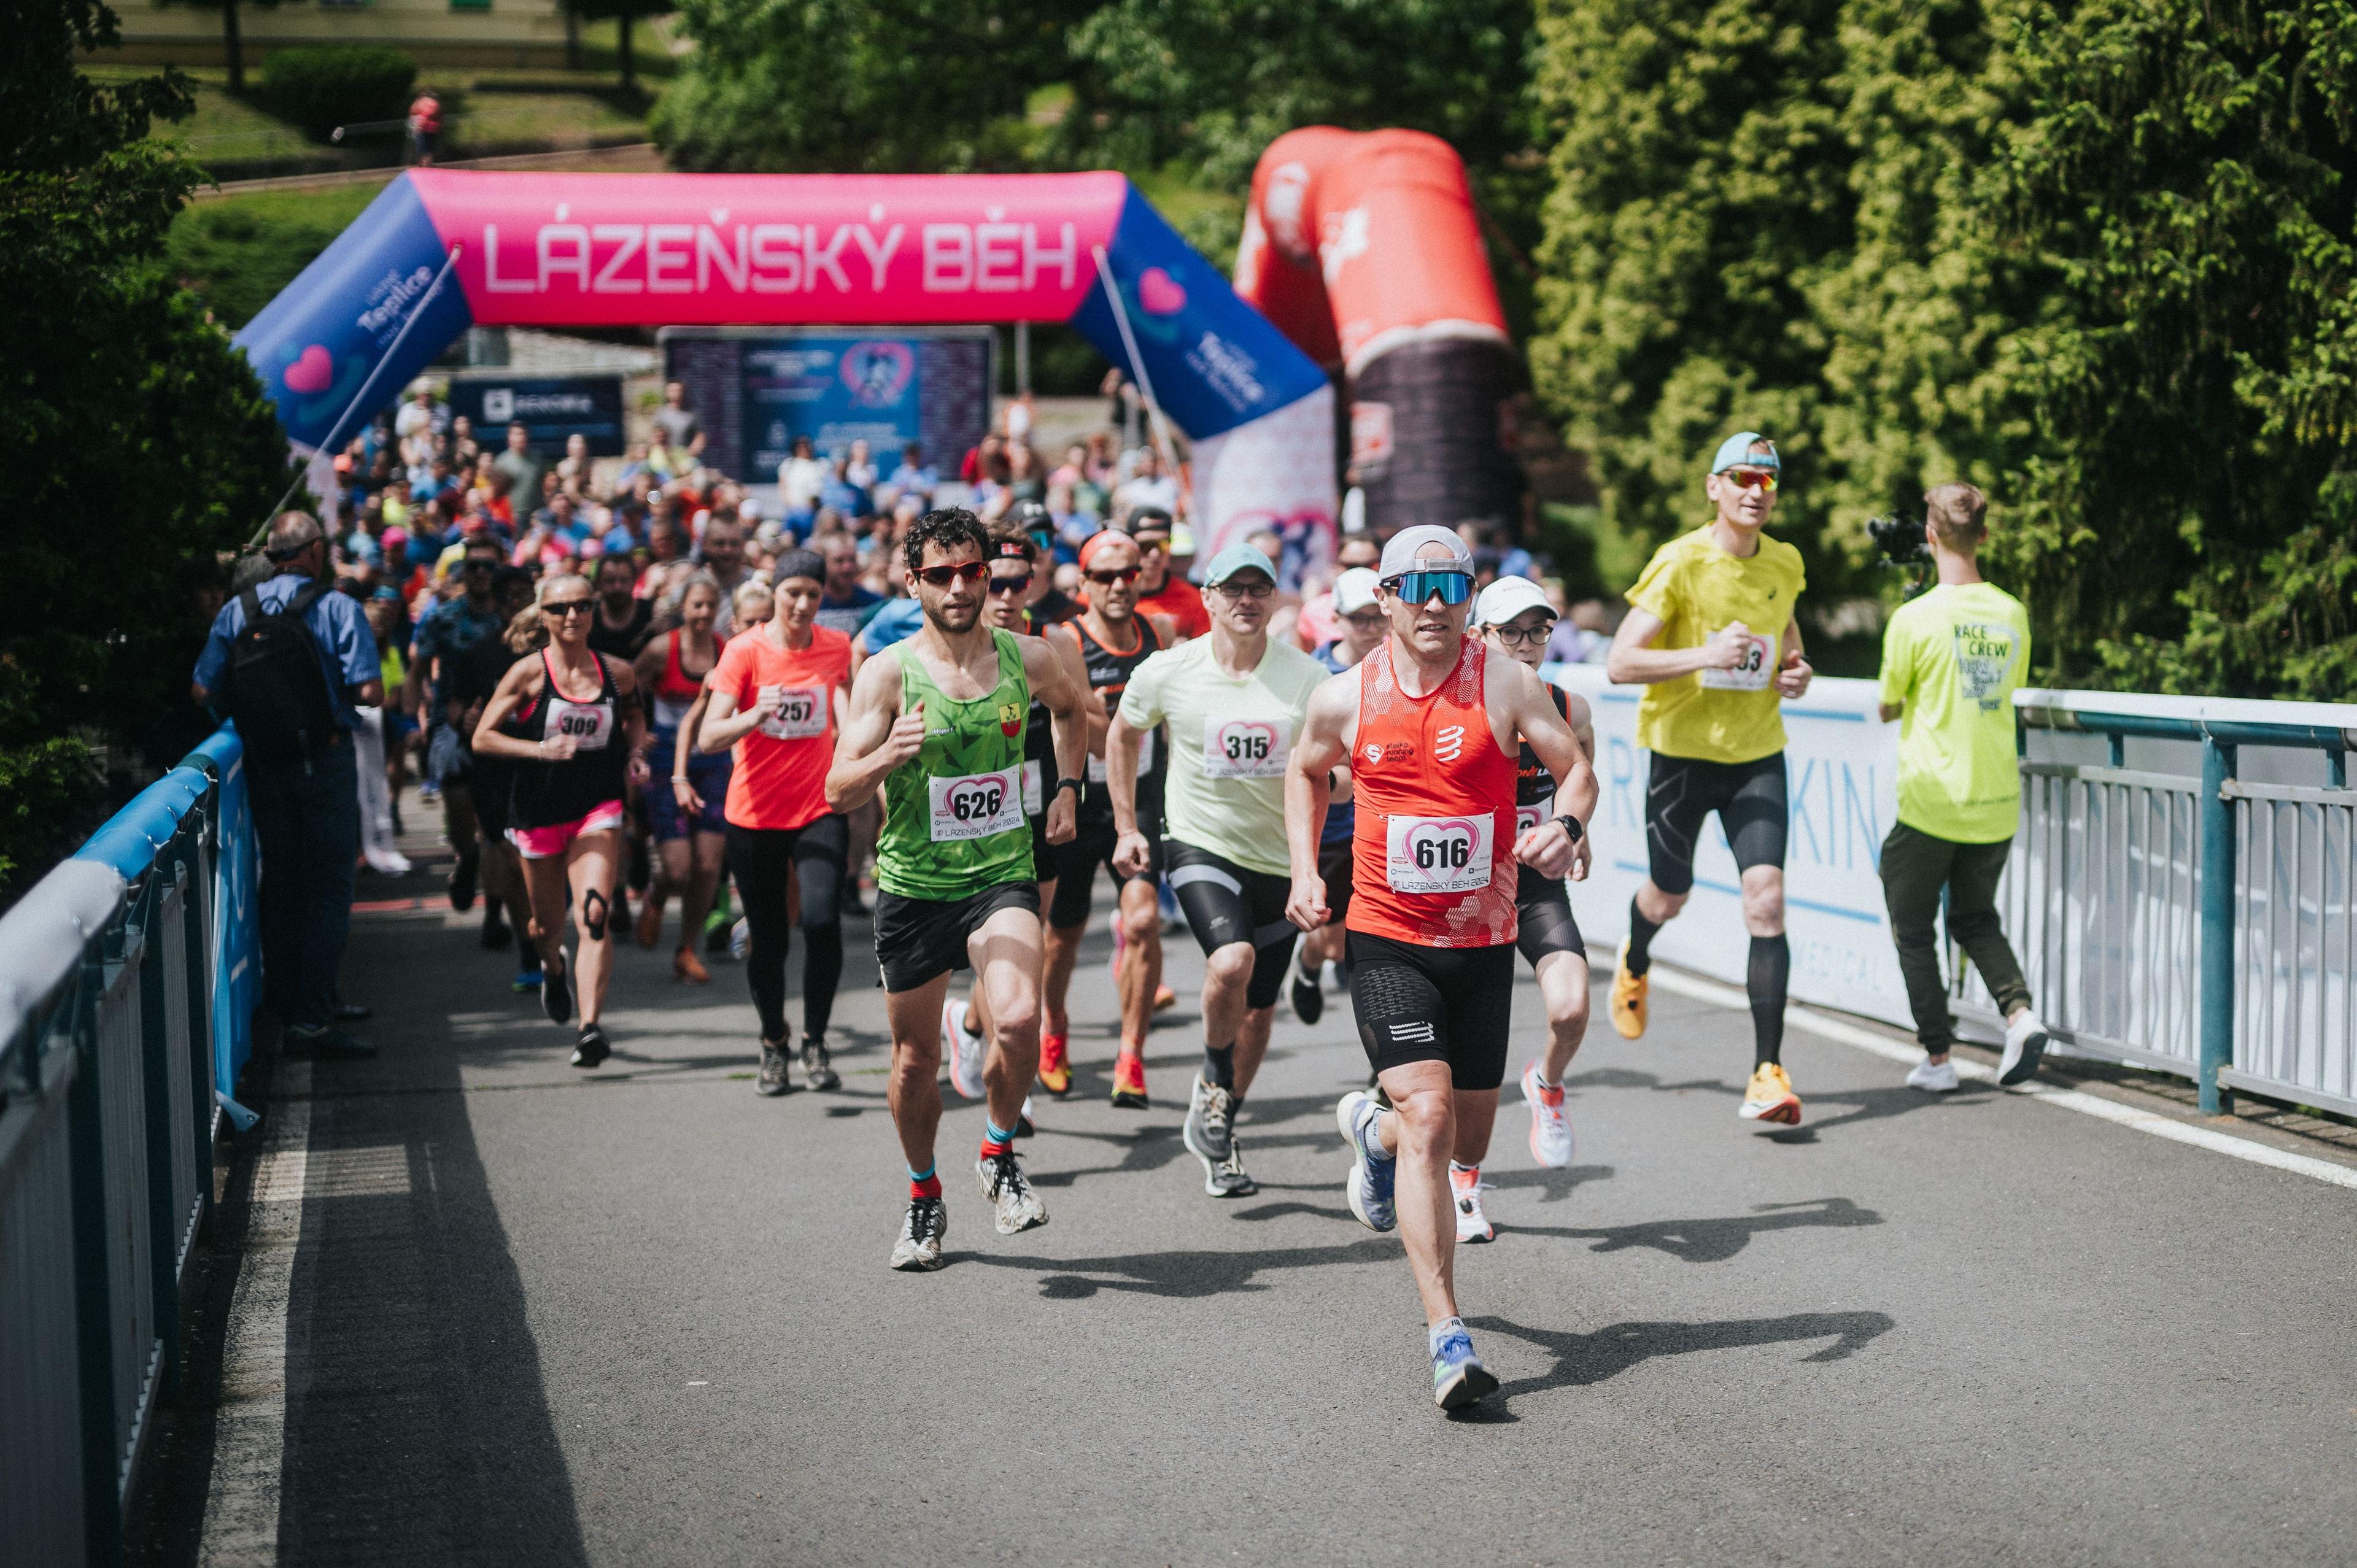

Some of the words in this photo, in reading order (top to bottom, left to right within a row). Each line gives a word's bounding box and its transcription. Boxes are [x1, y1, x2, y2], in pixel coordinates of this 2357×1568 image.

[484, 203, 905, 293] LÁZEŇSKÝ
[923, 204, 1077, 292] BĚH
[1954, 624, 1987, 639] RACE
[1969, 641, 2008, 657] CREW
[777, 701, 812, 721] 257
[561, 716, 597, 735] 309
[1226, 736, 1268, 759] 315
[954, 789, 1000, 821] 626
[1002, 816, 1020, 827] 2024
[1416, 838, 1469, 869] 616
[1452, 878, 1469, 889] BĚH
[1471, 876, 1489, 887] 2024
